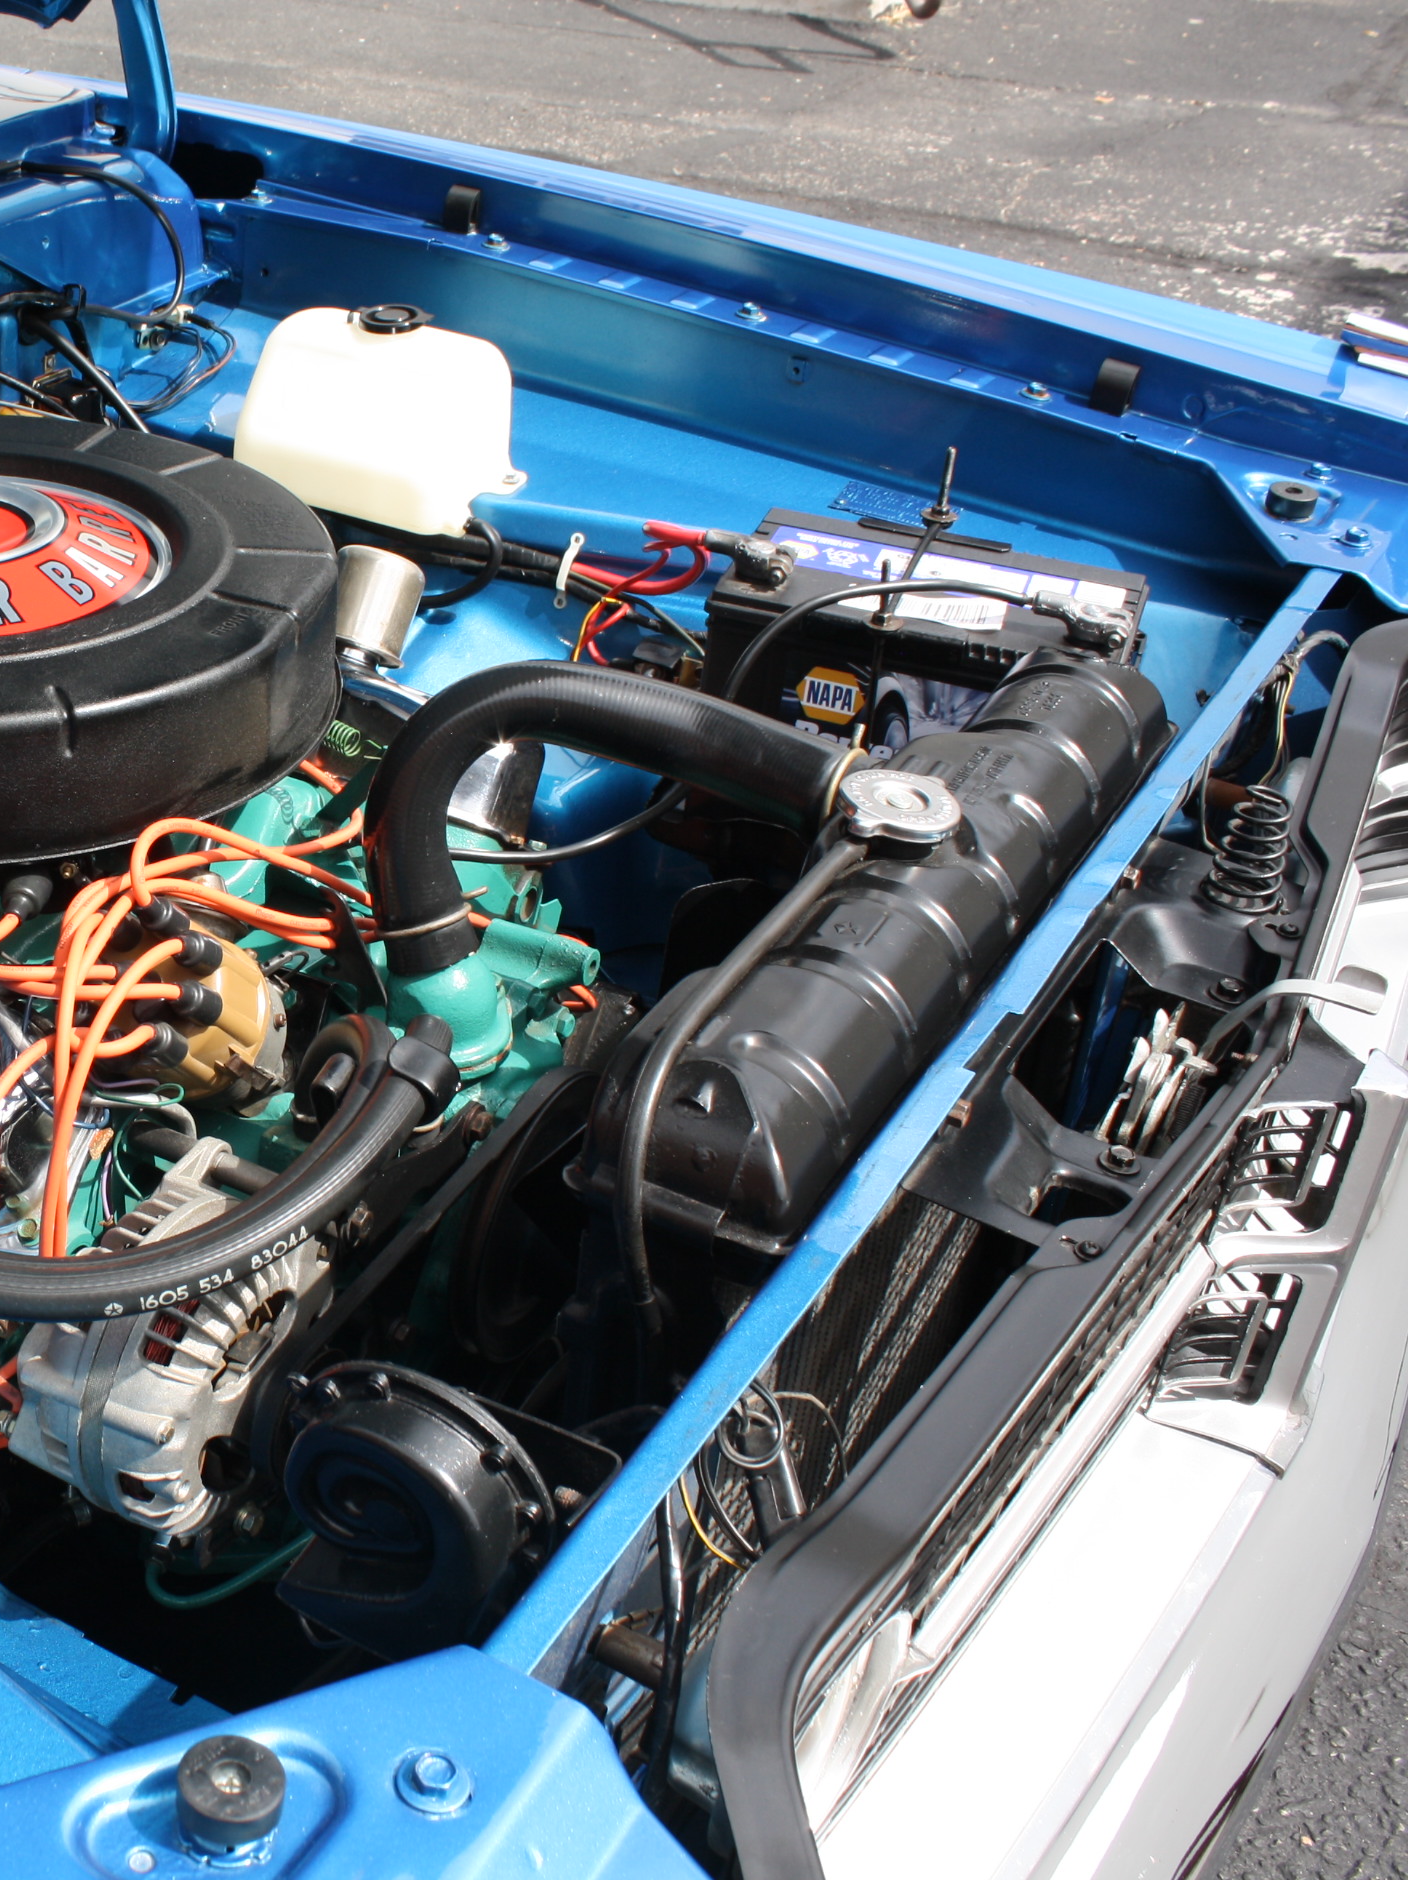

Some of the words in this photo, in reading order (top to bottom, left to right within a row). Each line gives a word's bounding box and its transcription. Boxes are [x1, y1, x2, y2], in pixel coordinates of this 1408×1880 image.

[806, 679, 854, 713] NAPA
[139, 1284, 190, 1310] 1605
[198, 1268, 235, 1294] 534
[250, 1225, 309, 1270] 83044
